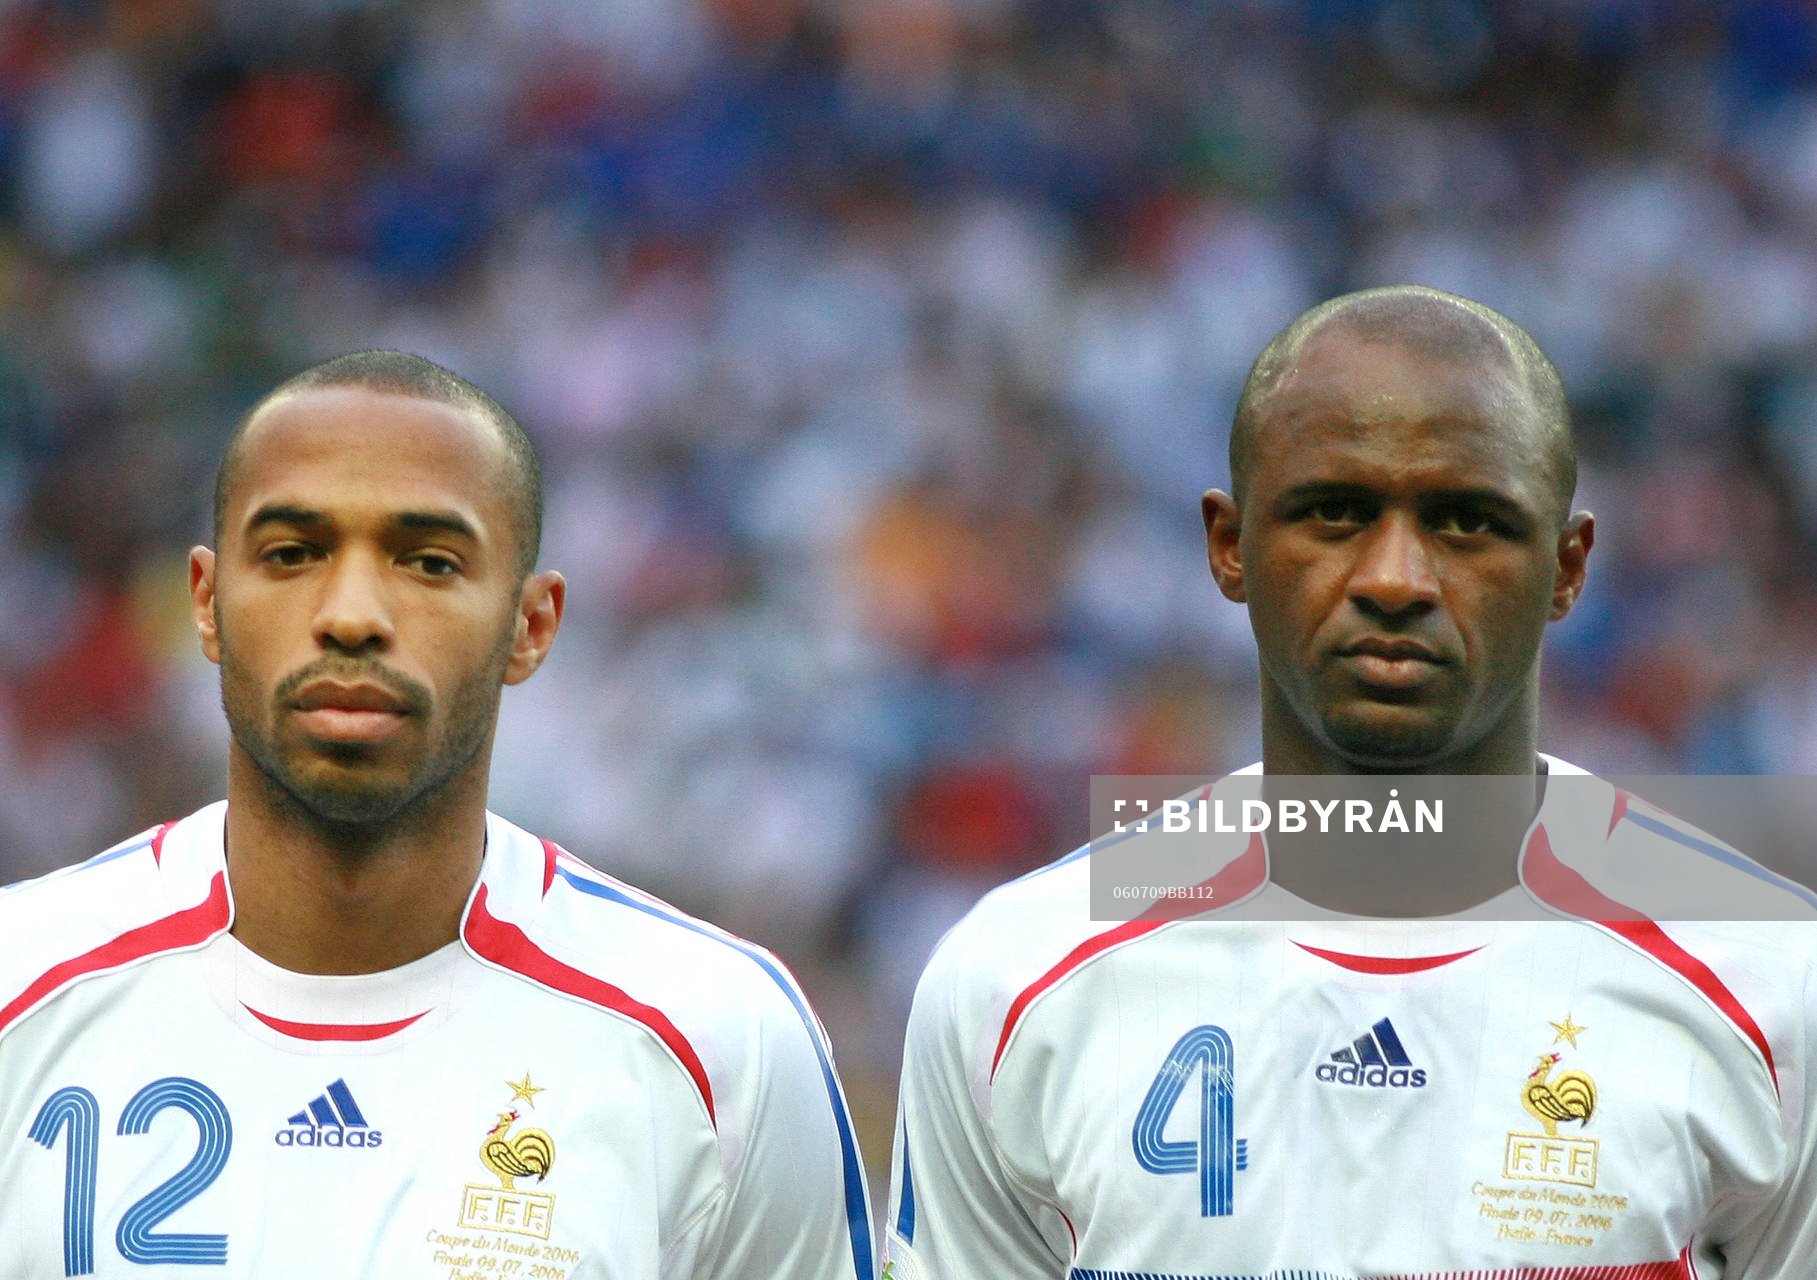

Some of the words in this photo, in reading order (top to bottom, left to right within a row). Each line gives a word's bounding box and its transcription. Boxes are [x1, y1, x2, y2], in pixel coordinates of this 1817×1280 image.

[1132, 1024, 1248, 1218] 4
[1316, 1061, 1427, 1088] adidas
[27, 1076, 233, 1277] 12
[275, 1124, 383, 1148] adidas
